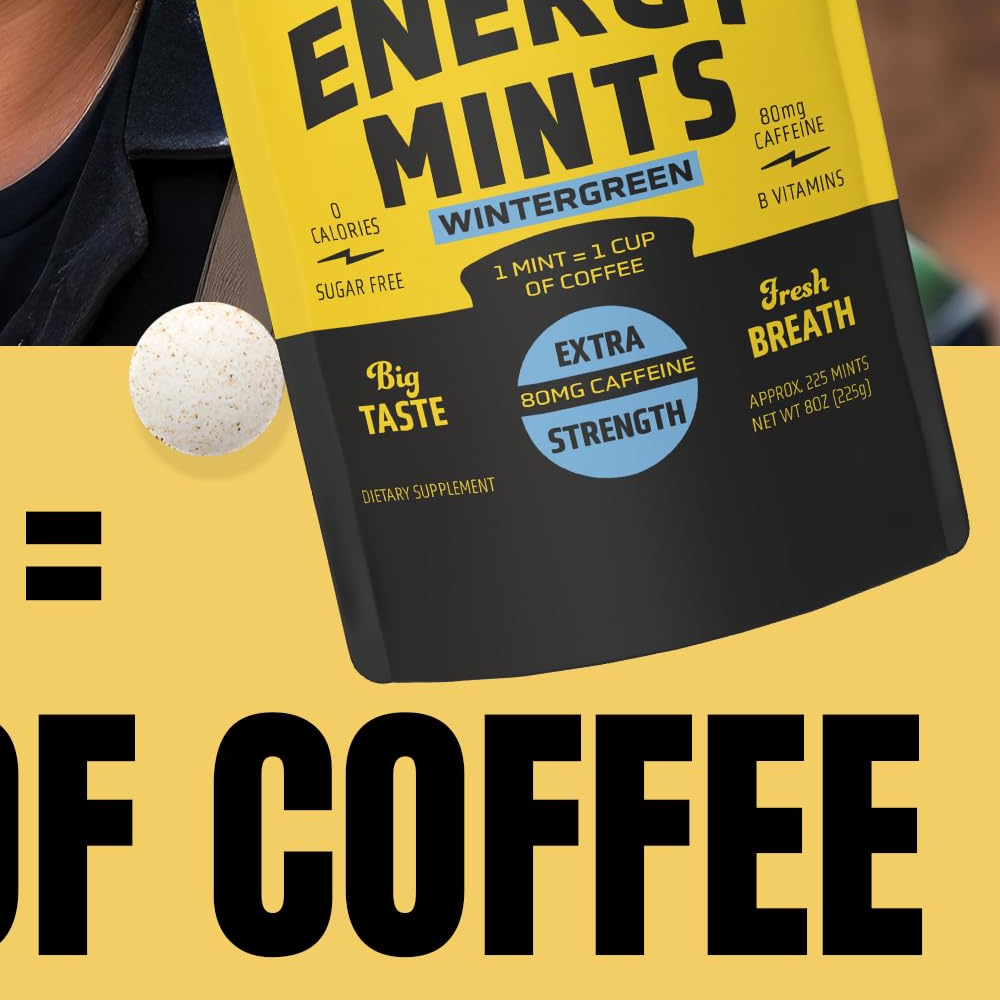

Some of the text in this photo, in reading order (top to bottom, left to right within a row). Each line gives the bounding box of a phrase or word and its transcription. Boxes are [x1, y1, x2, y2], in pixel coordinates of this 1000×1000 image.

[362, 39, 737, 209] MINTS
[754, 116, 825, 150] CAFFEINE
[760, 101, 806, 125] 80mg
[437, 159, 695, 237] WINTERGREEN
[758, 169, 845, 209] B VITAMINS
[311, 217, 380, 244] CALORIES
[330, 202, 341, 219] 0
[494, 265, 508, 281] 1
[512, 251, 567, 277] MINT
[592, 243, 606, 260] 1
[611, 231, 656, 255] CUP
[316, 272, 405, 301] SUGAR FREE
[525, 257, 645, 297] OF COFFEE
[760, 267, 830, 310] Fresh
[554, 325, 645, 367] EXTRA
[747, 296, 856, 359] BREATH
[366, 360, 420, 398] Big
[520, 355, 696, 408] 80MG CAFFEINE
[750, 355, 869, 409] APPROX. 225 MINTS
[358, 396, 448, 435] TASTE
[548, 398, 687, 454] STRENGTH
[752, 411, 777, 433] NET
[780, 403, 800, 423] WT
[832, 378, 872, 408] (225g)
[361, 476, 495, 504] DIETARY SUPPLEMENT
